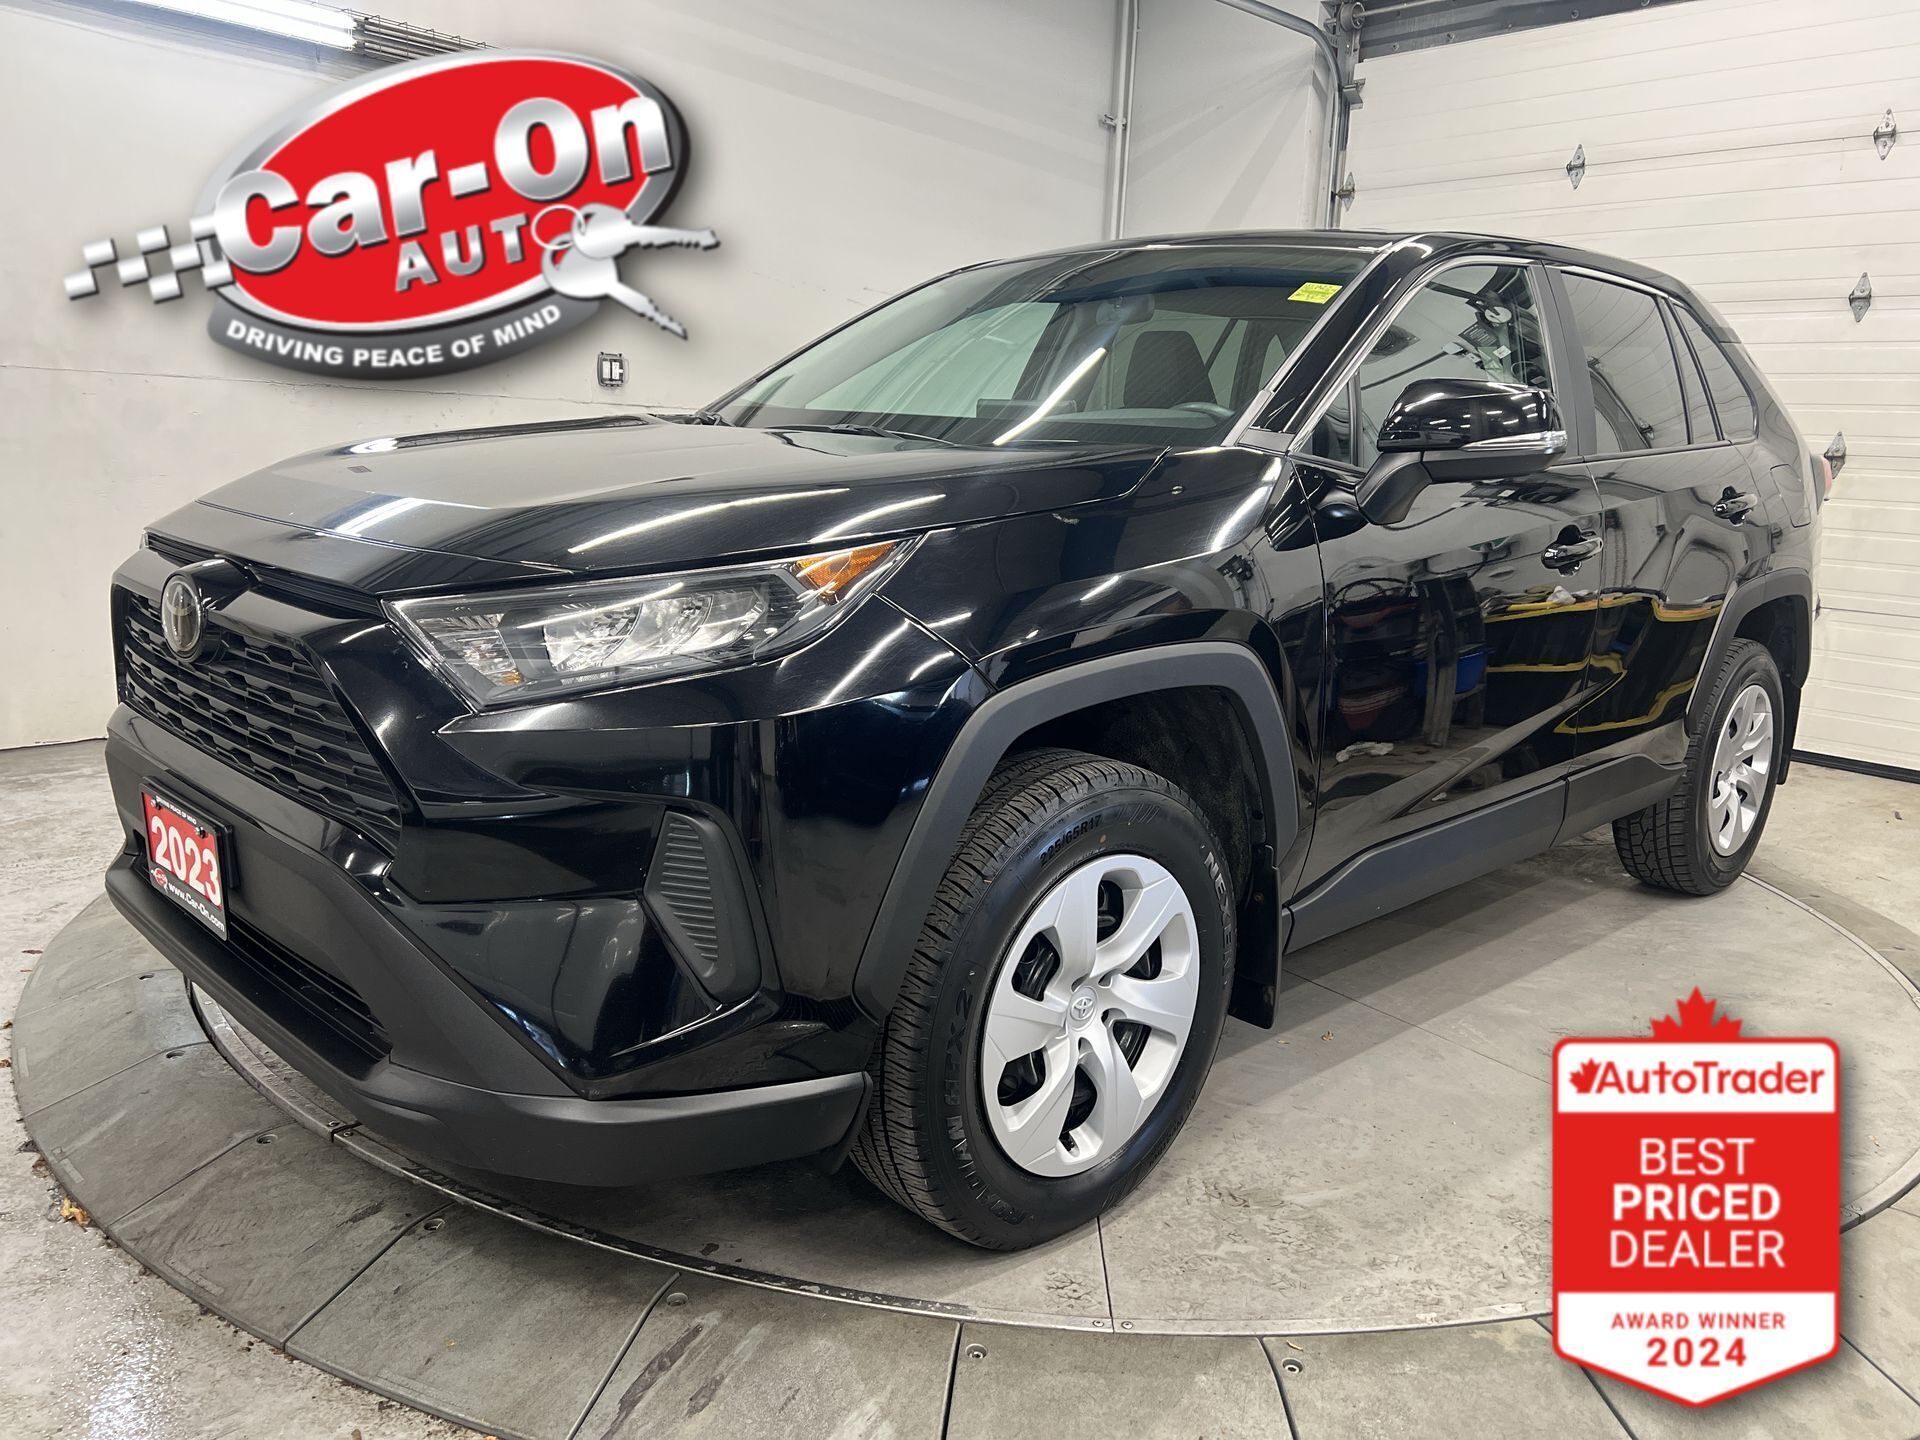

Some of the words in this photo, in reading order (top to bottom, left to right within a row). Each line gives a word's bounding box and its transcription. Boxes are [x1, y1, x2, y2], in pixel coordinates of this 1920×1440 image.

[151, 815, 221, 906] 2023
[1040, 814, 1102, 866] 225/65R17
[168, 882, 225, 932] www.Car-On.com
